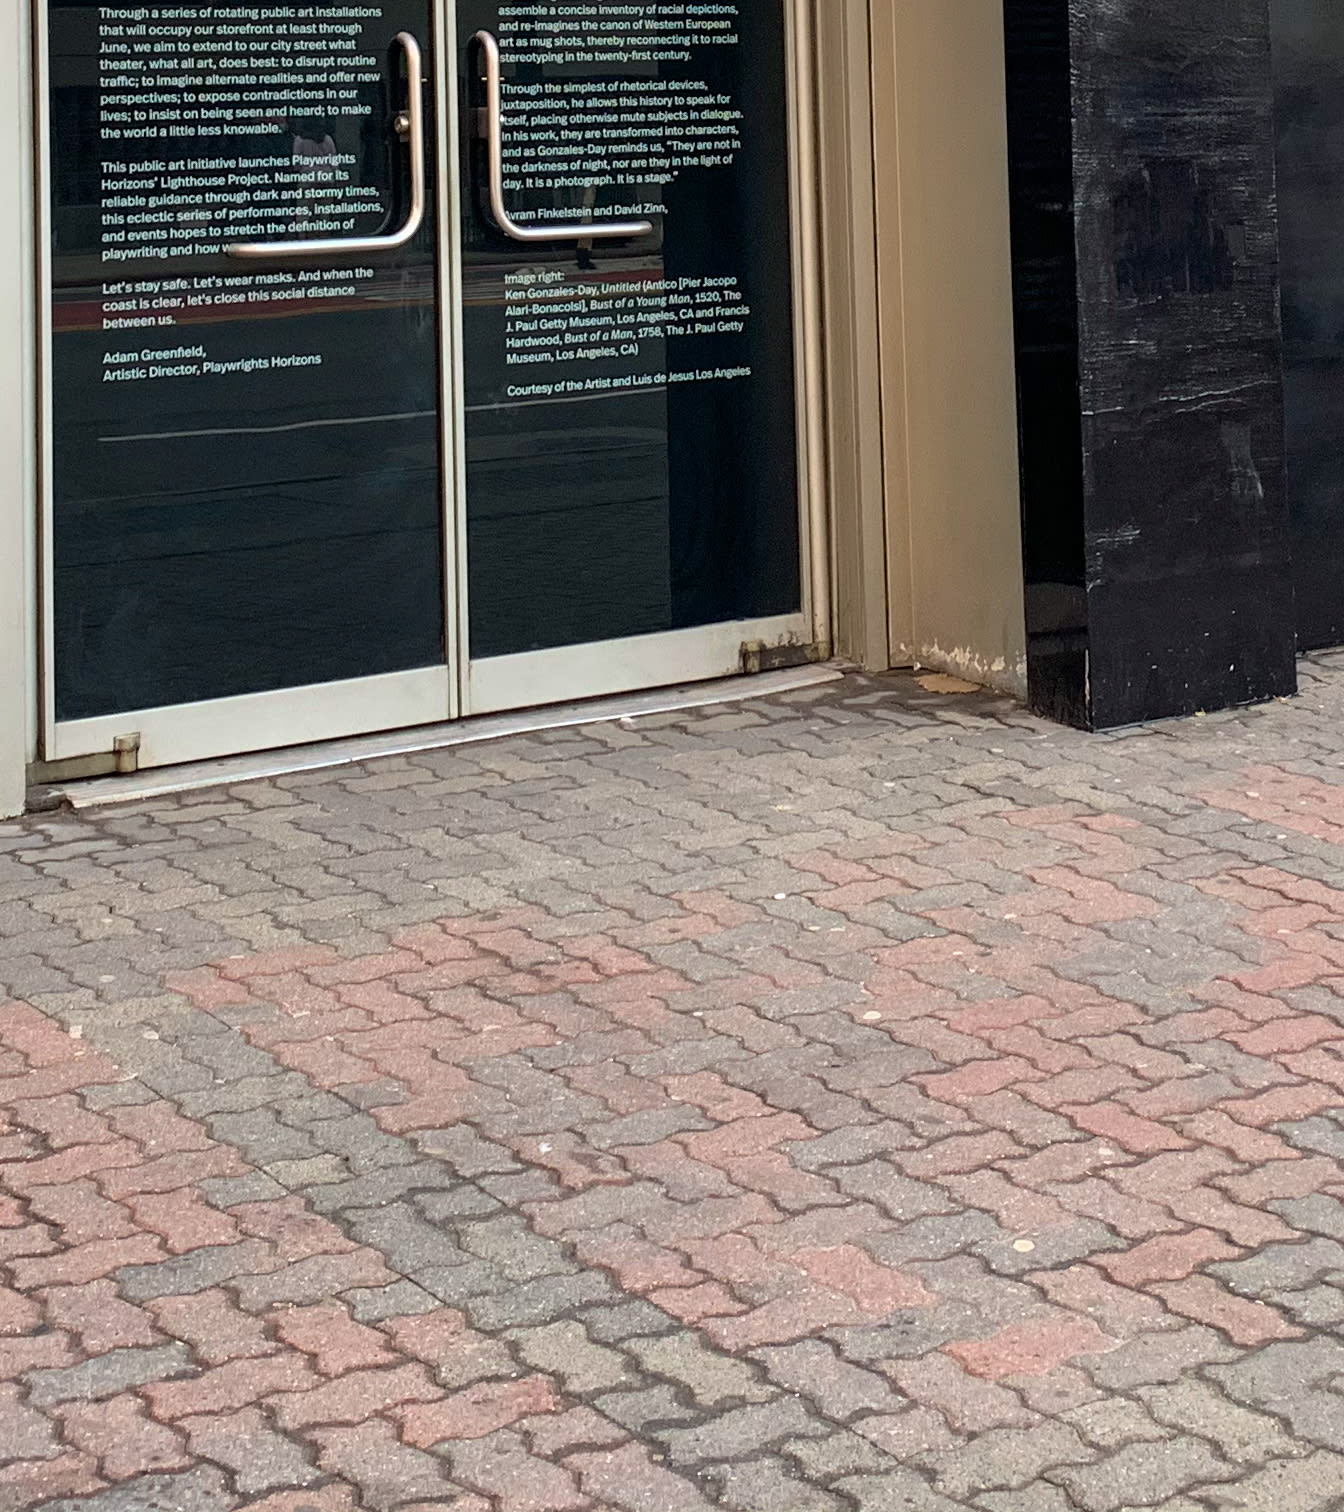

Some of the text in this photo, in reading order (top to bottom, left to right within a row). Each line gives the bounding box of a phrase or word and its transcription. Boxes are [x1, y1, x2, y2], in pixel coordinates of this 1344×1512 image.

[98, 6, 149, 20] Through
[161, 6, 197, 17] series
[198, 6, 212, 16] of
[213, 6, 259, 20] rotating
[260, 6, 295, 19] public
[297, 6, 314, 16] art
[315, 5, 382, 16] installations
[504, 288, 526, 299] Ken
[600, 280, 641, 293] Untitled
[641, 277, 677, 292] (Antico
[678, 275, 701, 289] [Pier
[702, 273, 737, 289] Jacopo
[102, 345, 206, 362] Adam Greenfield,
[102, 352, 321, 380] Artistic Director, Playwrights Horizons
[507, 364, 751, 399] Courtesy of the Artist and Luis de Jesus Los Angeles
